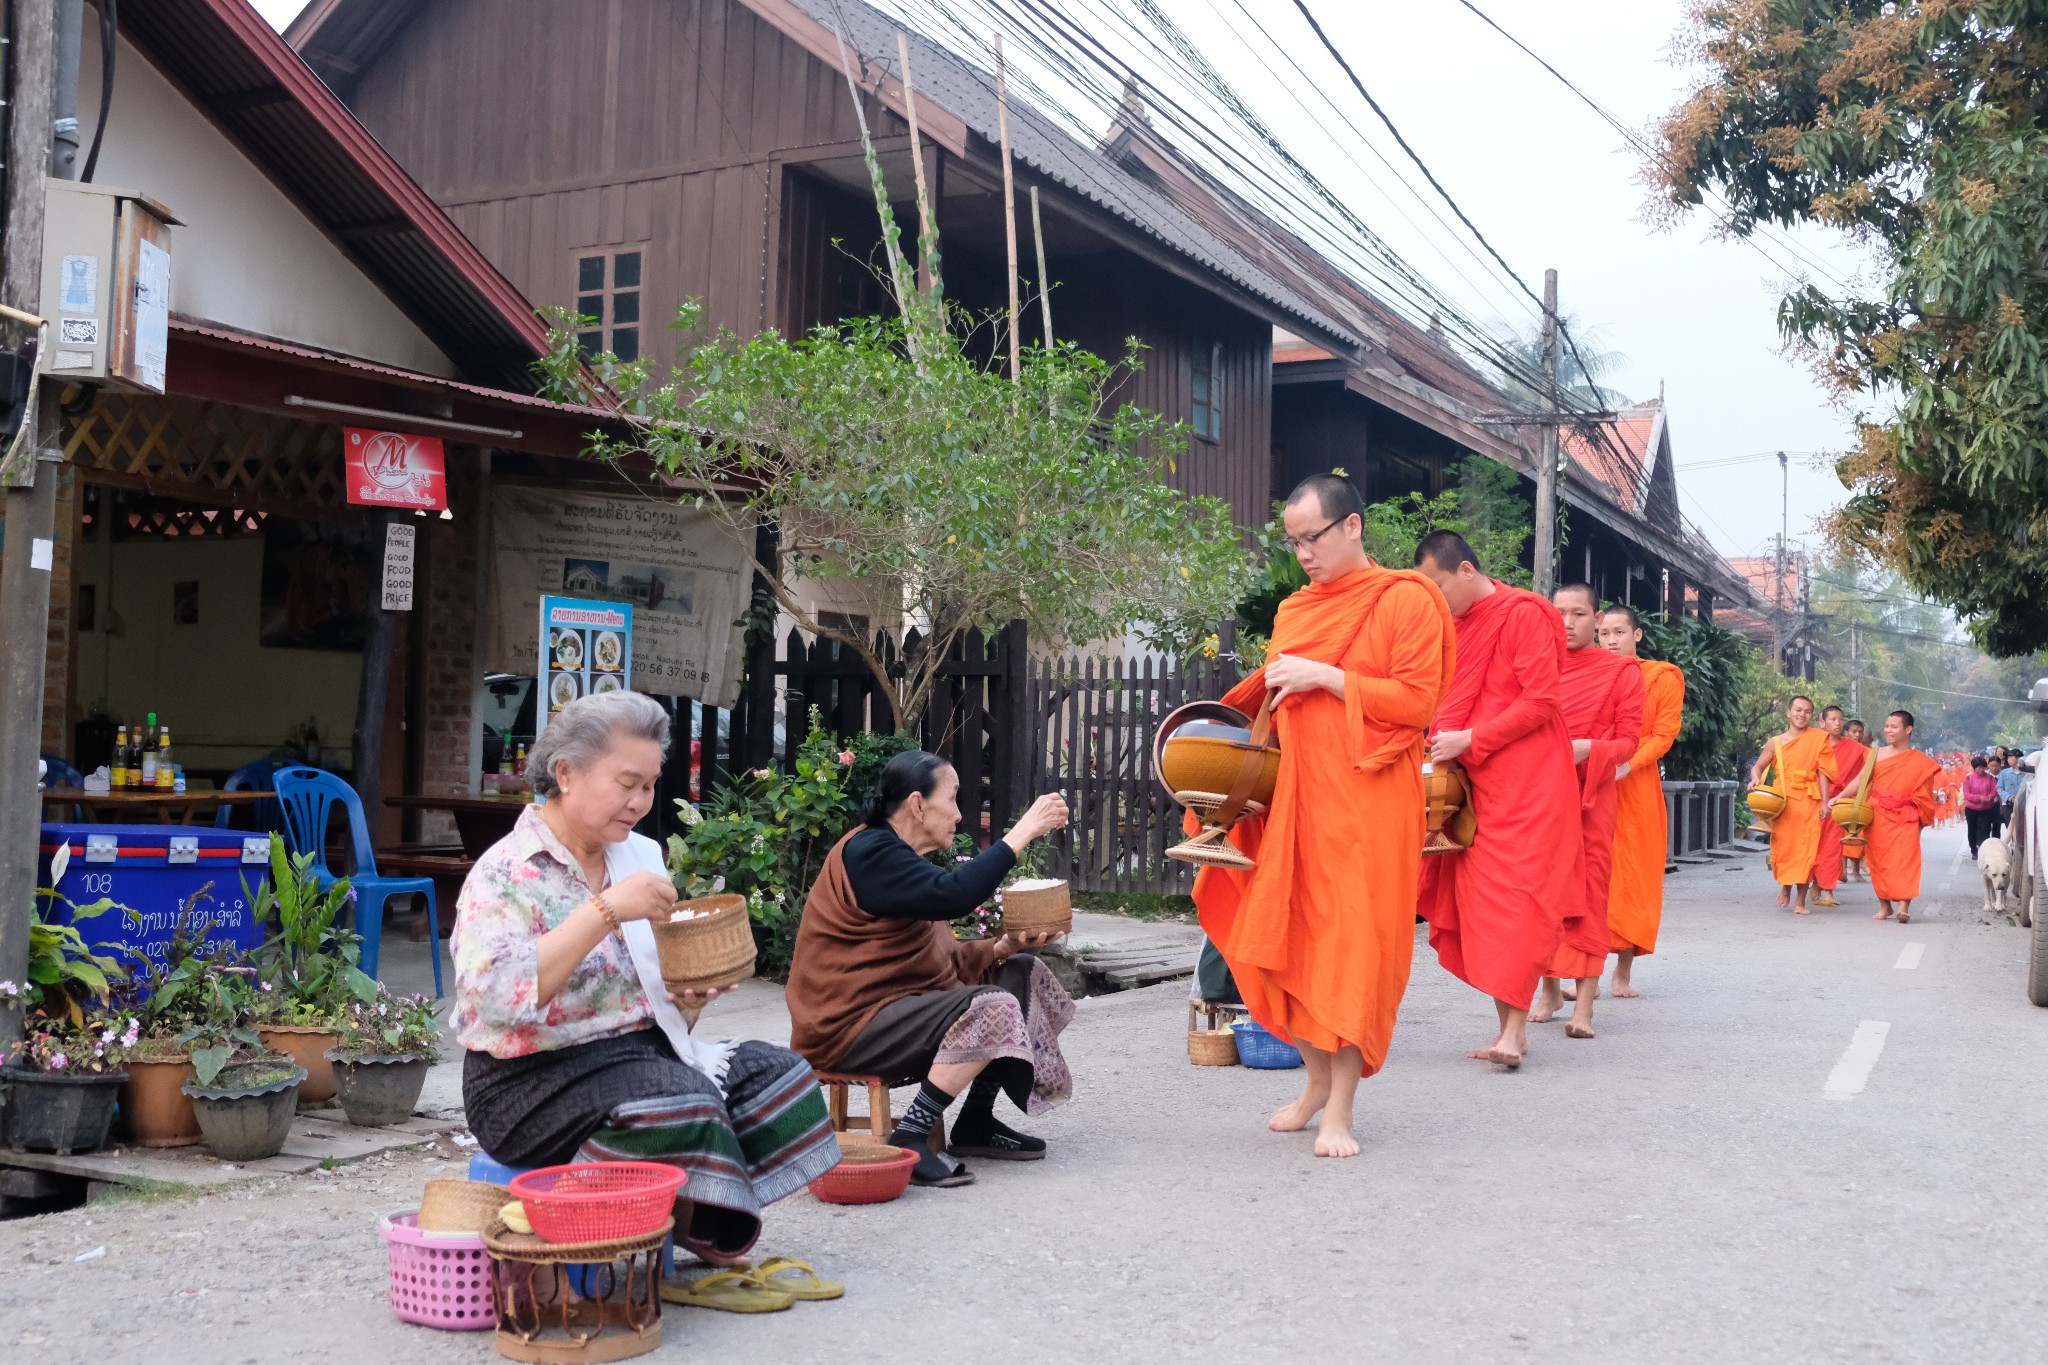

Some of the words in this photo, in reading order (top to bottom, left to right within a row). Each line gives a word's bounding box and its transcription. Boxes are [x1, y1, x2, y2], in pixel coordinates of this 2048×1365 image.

[391, 526, 415, 537] GOOD
[387, 537, 411, 548] PEOPLE
[387, 553, 409, 562] GOOD
[387, 565, 411, 576] FOOD
[386, 580, 412, 589] GOOD
[649, 663, 663, 675] 56
[667, 666, 681, 677] 37
[683, 669, 697, 681] 09
[81, 873, 112, 894] 108
